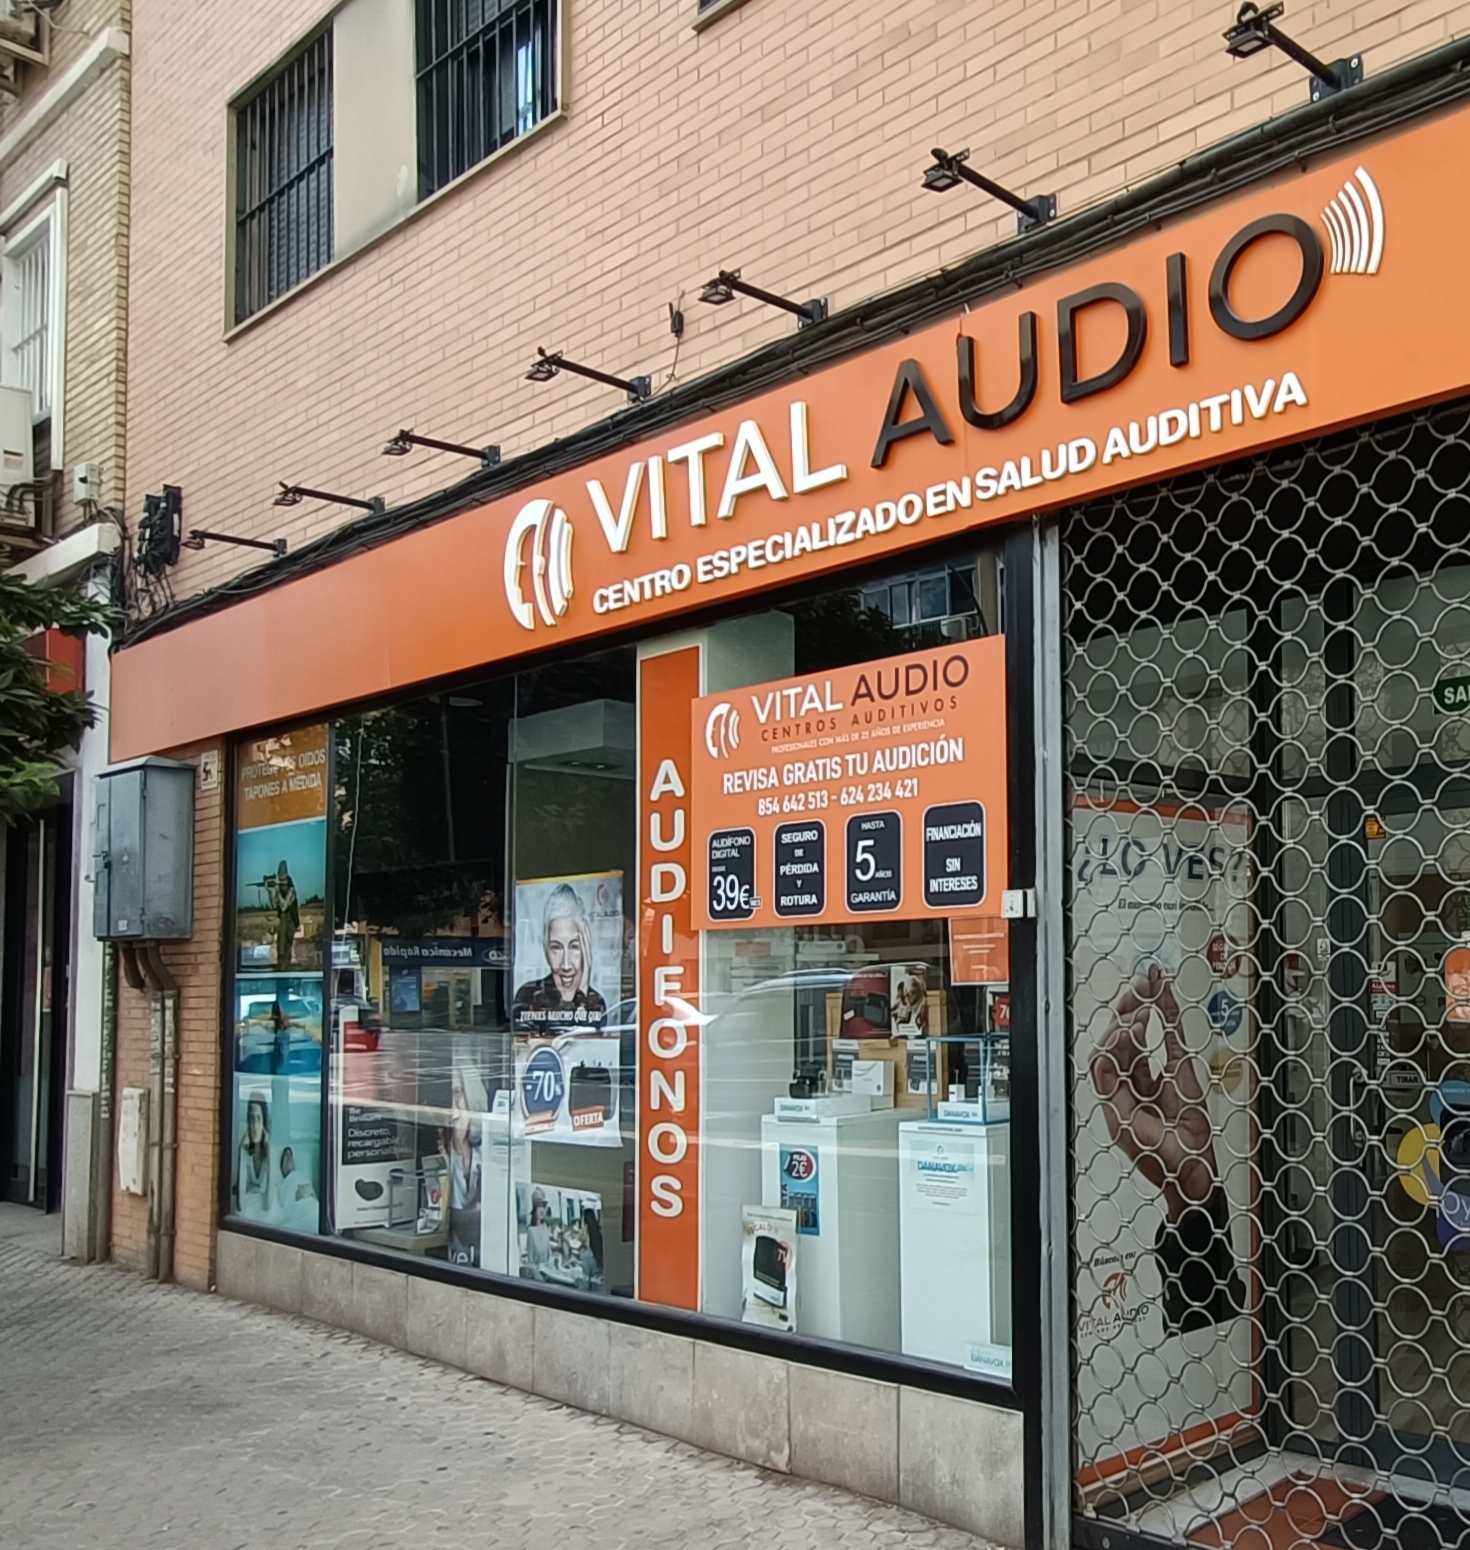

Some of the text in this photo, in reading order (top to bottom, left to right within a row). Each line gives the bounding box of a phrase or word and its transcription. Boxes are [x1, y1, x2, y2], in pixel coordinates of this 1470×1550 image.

[586, 212, 1324, 553] VITAL AUDIO
[593, 371, 1308, 615] CENTRO ESPECIALIZADO EN SALUD AUDITIVA
[751, 655, 969, 724] VITAL AUDIO
[761, 695, 958, 743] CENTROS AUDITIVOS
[771, 738, 818, 755] PROFESIONALES
[818, 736, 835, 748] CON
[850, 732, 860, 742] DE
[871, 726, 891, 739] AÑOS
[892, 725, 901, 735] DE
[902, 717, 946, 733] EXPERIENCIA
[722, 734, 965, 796] REVISA GRATIS TU AUDICIÓN
[244, 770, 323, 802] TAPONES A MEDIDA
[758, 793, 781, 818] 854
[782, 791, 806, 814] 642
[807, 789, 830, 811] 513
[840, 784, 865, 808] 624
[866, 780, 893, 803] 234
[895, 776, 919, 799] 421
[861, 820, 886, 831] HASTA
[925, 820, 982, 842] FINANCIACIÓN
[711, 835, 752, 849] AUDÍFONO
[781, 829, 819, 844] SEGURO
[711, 848, 741, 860] DIGITAL
[793, 848, 805, 858] DE
[855, 839, 876, 882] 5
[779, 861, 820, 877] PÉRDIDA
[945, 857, 962, 873] SIN
[712, 873, 751, 911] 39€
[796, 879, 803, 889] Y
[929, 874, 979, 893] INTERESES
[780, 893, 818, 907] ROTURA
[850, 887, 897, 904] GARANTÍA
[647, 758, 689, 1218] AUDIFONOS
[1396, 1076, 1419, 1084] TIRAR
[573, 1111, 604, 1128] OFERTA
[791, 1160, 808, 1178] 2€
[777, 1248, 787, 1264] TV
